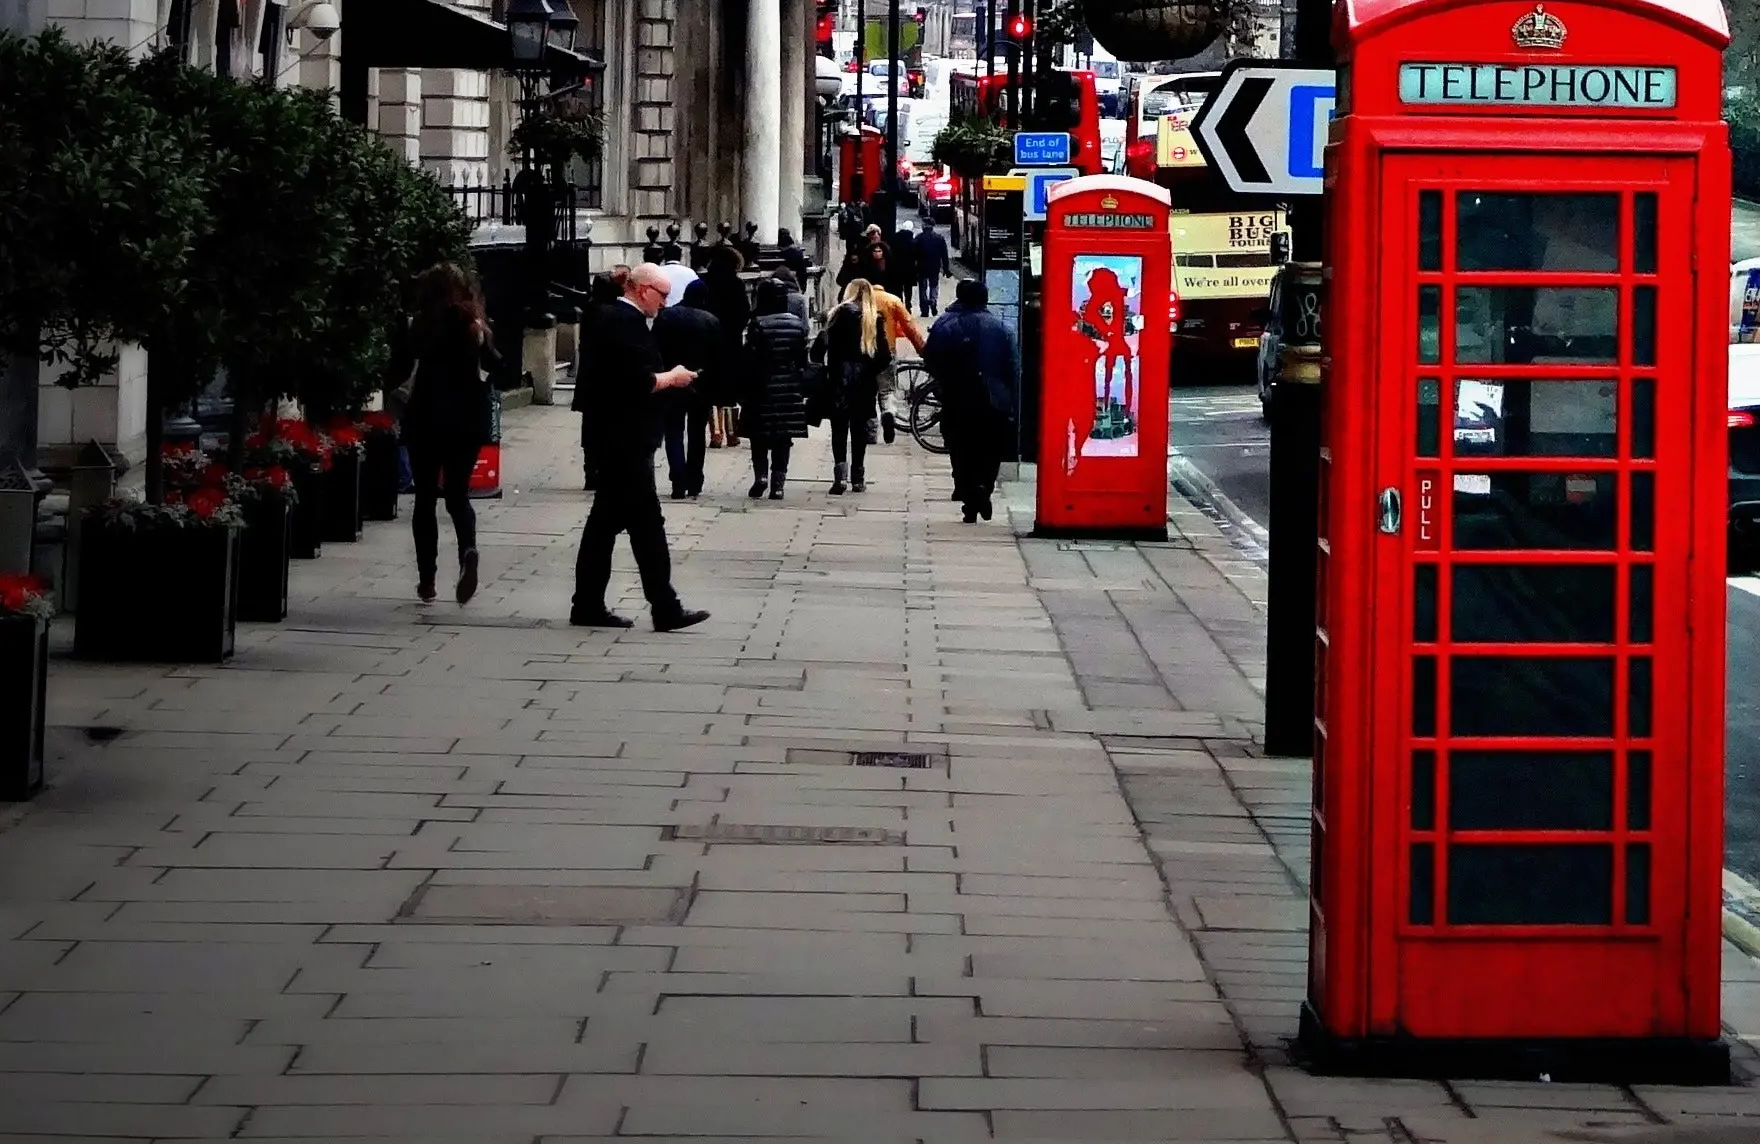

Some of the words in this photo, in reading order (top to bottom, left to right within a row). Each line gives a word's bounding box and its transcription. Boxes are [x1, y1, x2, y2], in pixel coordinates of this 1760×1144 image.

[1409, 66, 1666, 104] TELEPHONE
[1025, 137, 1046, 147] End
[1048, 137, 1060, 147] of
[1020, 149, 1039, 159] bus
[1042, 149, 1065, 159] lane
[1068, 214, 1150, 227] TELEPHONE
[1229, 215, 1274, 228] BIG
[1229, 227, 1274, 240] BUS
[1184, 277, 1219, 288] We're
[1223, 276, 1238, 287] all
[1242, 279, 1269, 287] over
[1420, 480, 1432, 540] PULL
